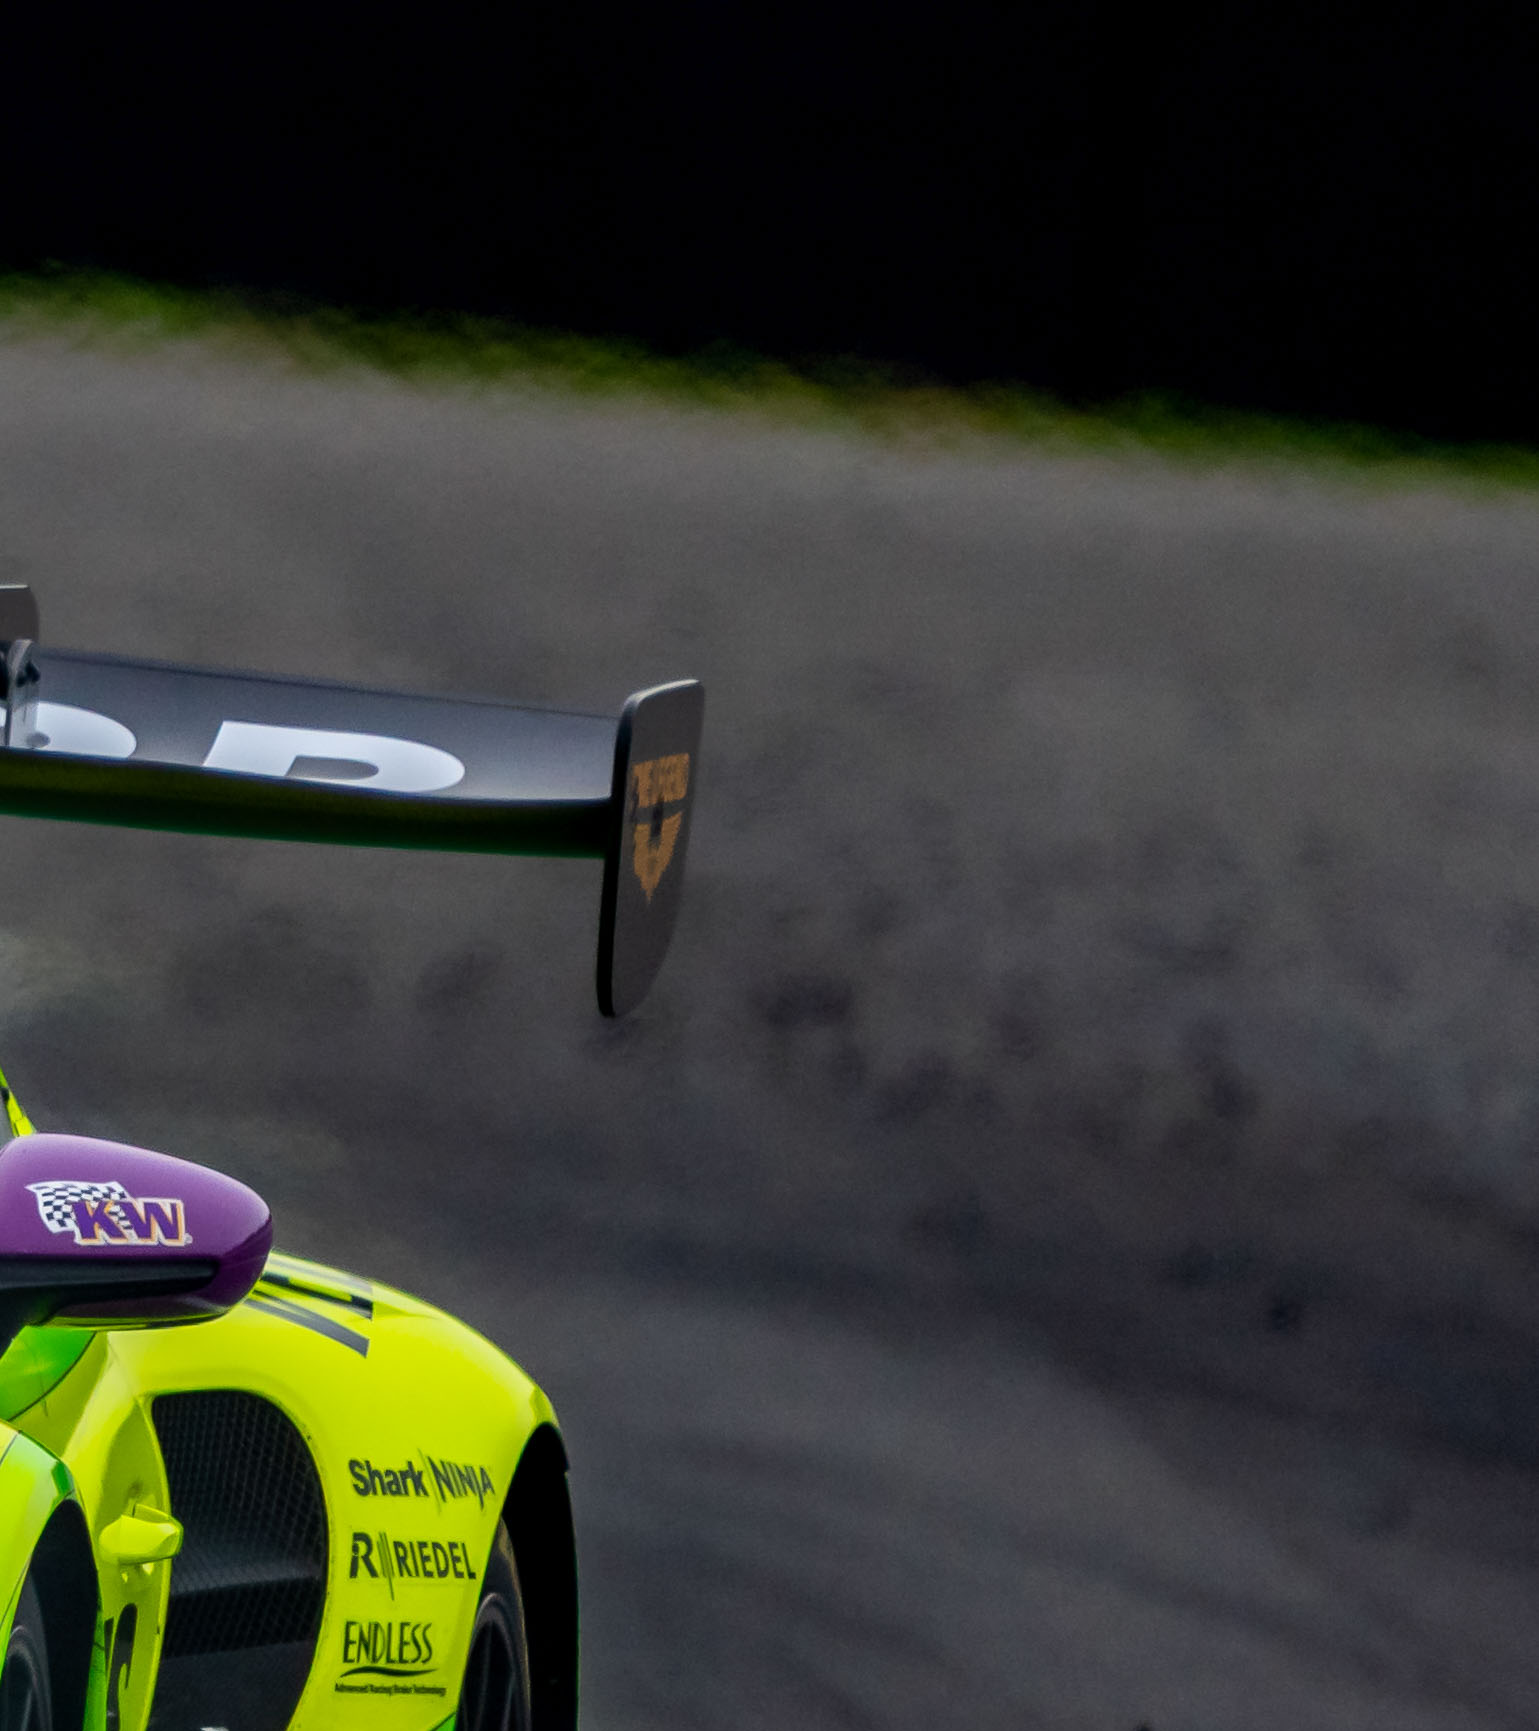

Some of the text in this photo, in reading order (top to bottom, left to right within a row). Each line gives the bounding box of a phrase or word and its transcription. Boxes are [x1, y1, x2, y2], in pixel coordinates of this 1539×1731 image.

[72, 1196, 187, 1247] KW
[392, 1541, 477, 1580] RIEDEL
[341, 1620, 434, 1665] ENDLESS
